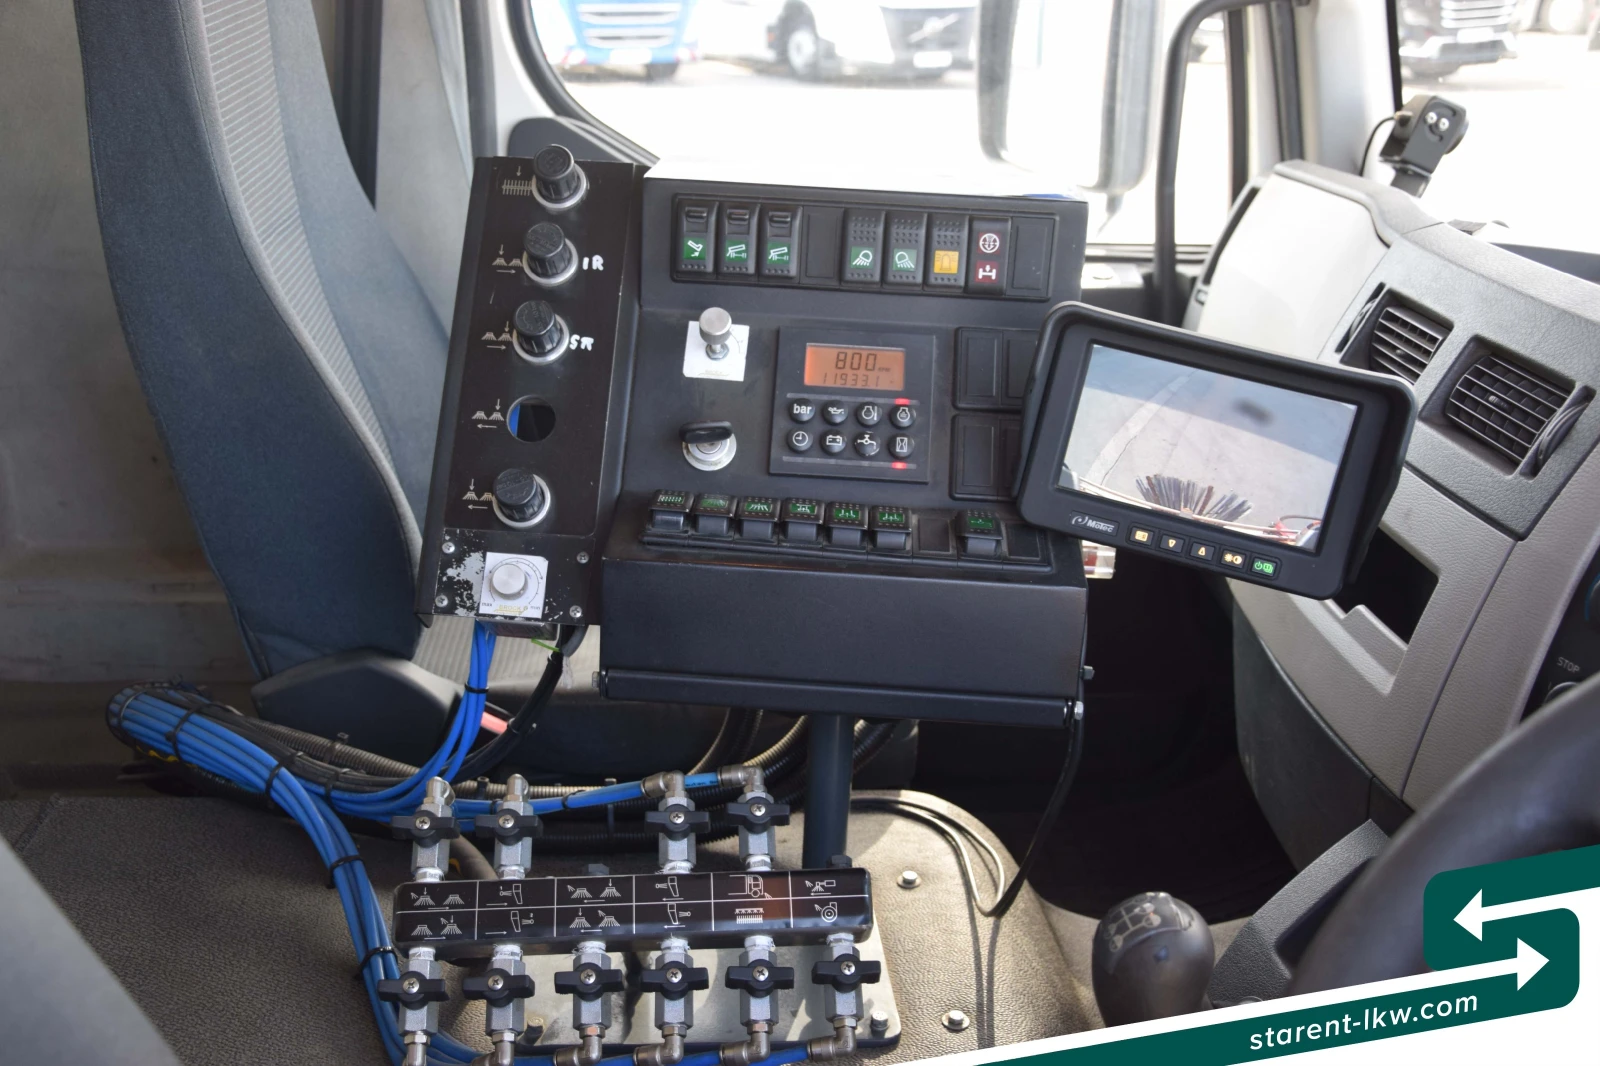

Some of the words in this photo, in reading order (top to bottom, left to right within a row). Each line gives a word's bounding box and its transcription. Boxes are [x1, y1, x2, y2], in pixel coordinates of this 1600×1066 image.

[835, 351, 877, 371] 800
[793, 403, 812, 414] bar
[1556, 656, 1581, 673] STOP
